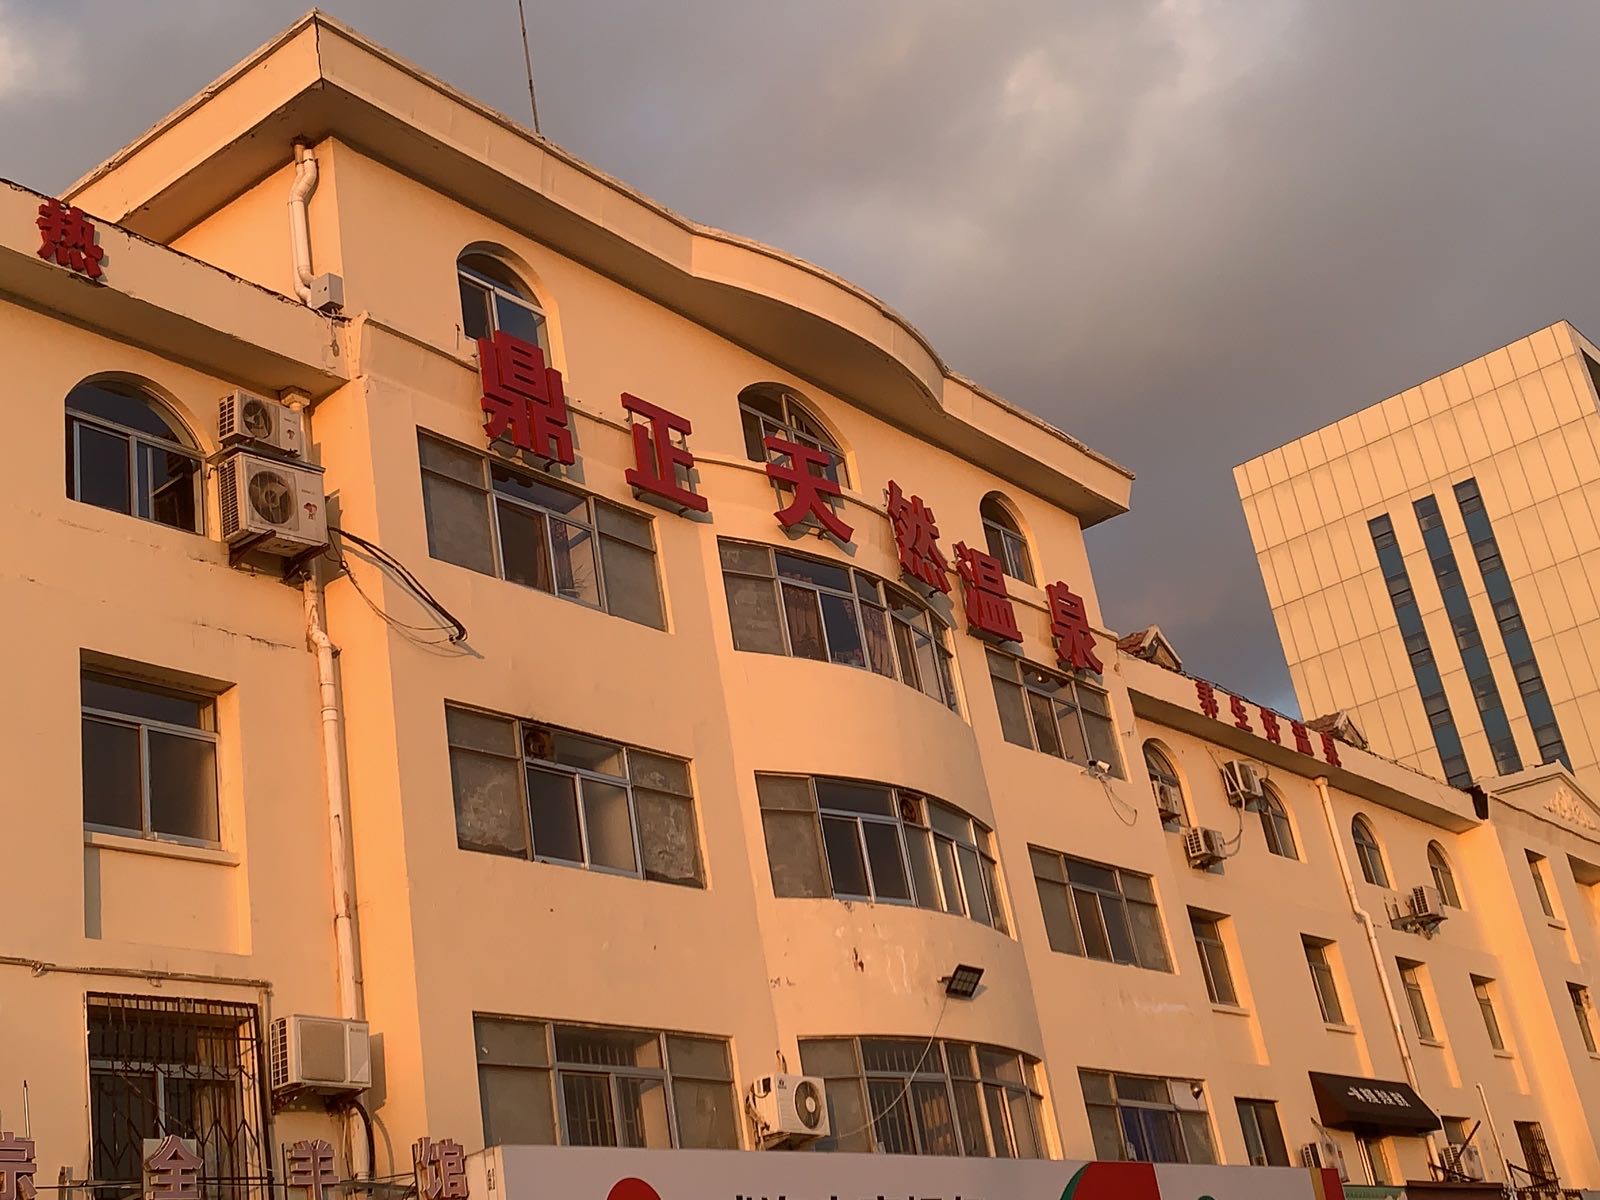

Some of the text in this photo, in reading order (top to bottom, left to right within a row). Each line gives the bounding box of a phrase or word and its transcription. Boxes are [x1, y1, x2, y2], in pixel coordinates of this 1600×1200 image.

[36, 198, 103, 278] 热
[478, 330, 1103, 675] 鼎正天然温泉
